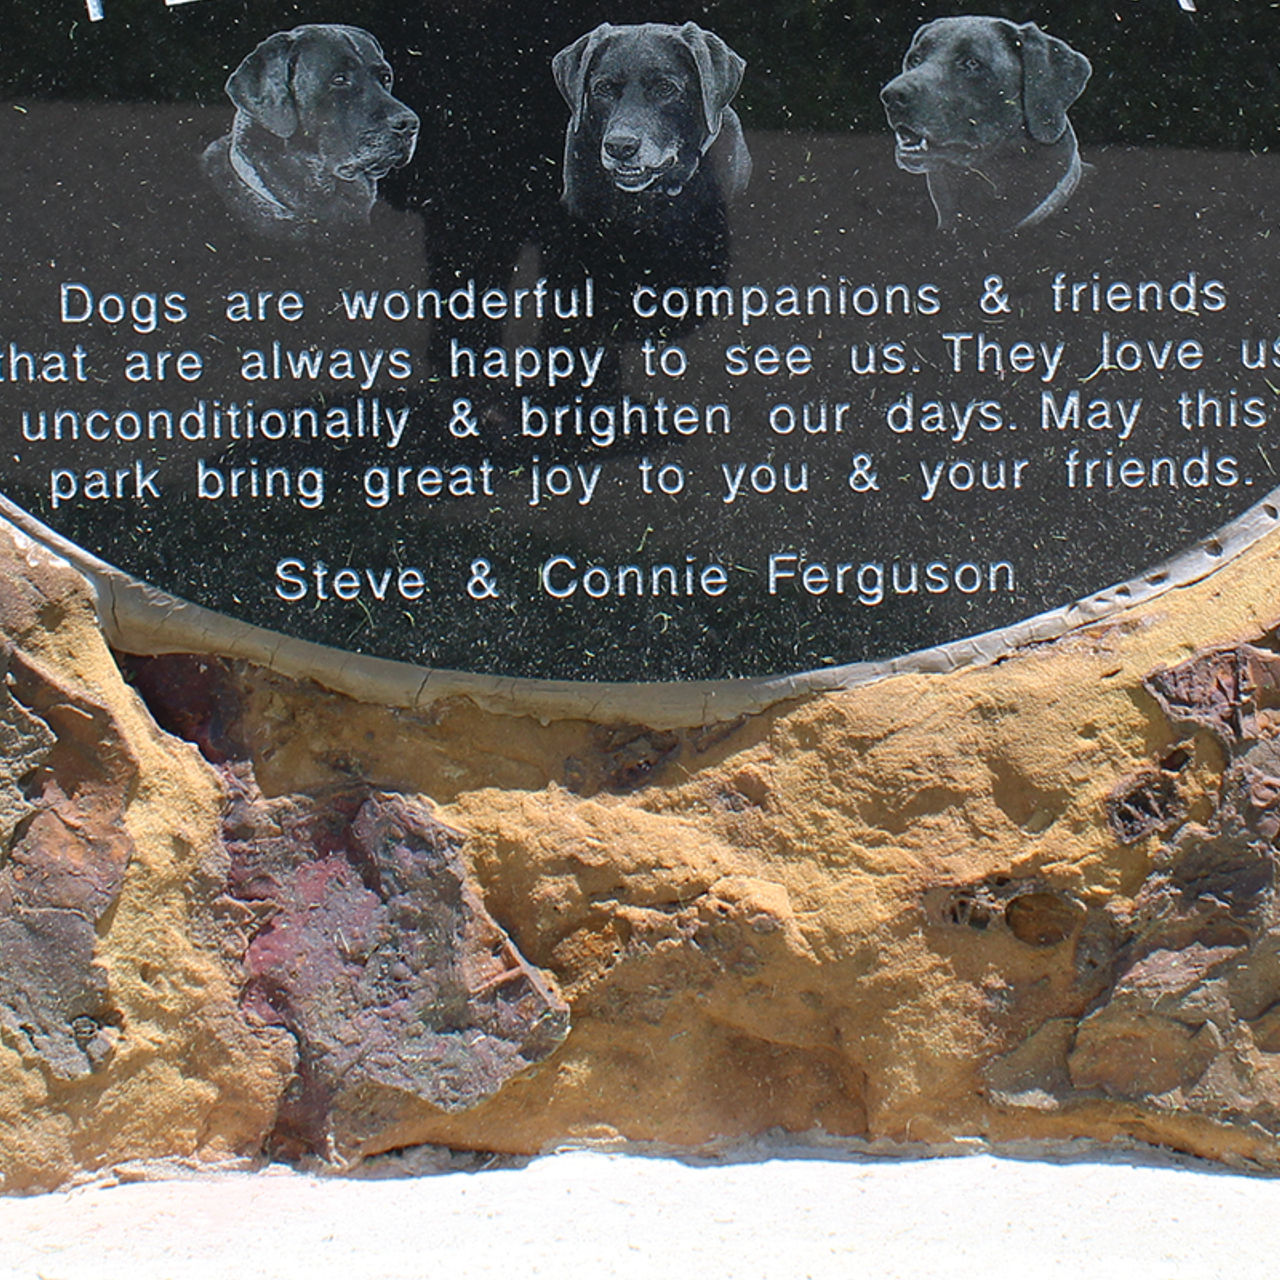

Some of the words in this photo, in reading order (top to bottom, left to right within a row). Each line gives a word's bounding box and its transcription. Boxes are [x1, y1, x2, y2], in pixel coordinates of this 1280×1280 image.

[60, 282, 188, 333] Dogs
[226, 291, 304, 322] are
[341, 278, 594, 321] wonderful
[632, 275, 941, 327] companions
[979, 275, 1011, 315] &
[1051, 271, 1227, 313] friends
[124, 351, 203, 382] are
[241, 341, 412, 390] always
[450, 339, 605, 388] happy
[641, 339, 687, 377] to
[725, 343, 814, 376] see
[851, 341, 921, 374] us.
[941, 332, 1065, 383] They
[1103, 331, 1204, 372] love
[22, 398, 410, 448] unconditionally
[448, 398, 480, 439] &
[521, 396, 731, 448] brighten
[769, 403, 851, 435] our
[886, 392, 1018, 442] days.
[1041, 390, 1143, 440] May
[1177, 389, 1267, 431] this
[50, 459, 161, 509] park
[197, 459, 324, 509] bring
[363, 459, 494, 508] great
[528, 456, 602, 506] joy
[638, 457, 685, 495] to
[721, 463, 809, 504] you
[848, 453, 880, 493] &
[919, 459, 1030, 501] your
[1065, 447, 1254, 489] friends.
[275, 557, 425, 602] Steve
[466, 558, 500, 600] &
[537, 555, 728, 599] Connie
[767, 553, 1015, 606] Ferguson
